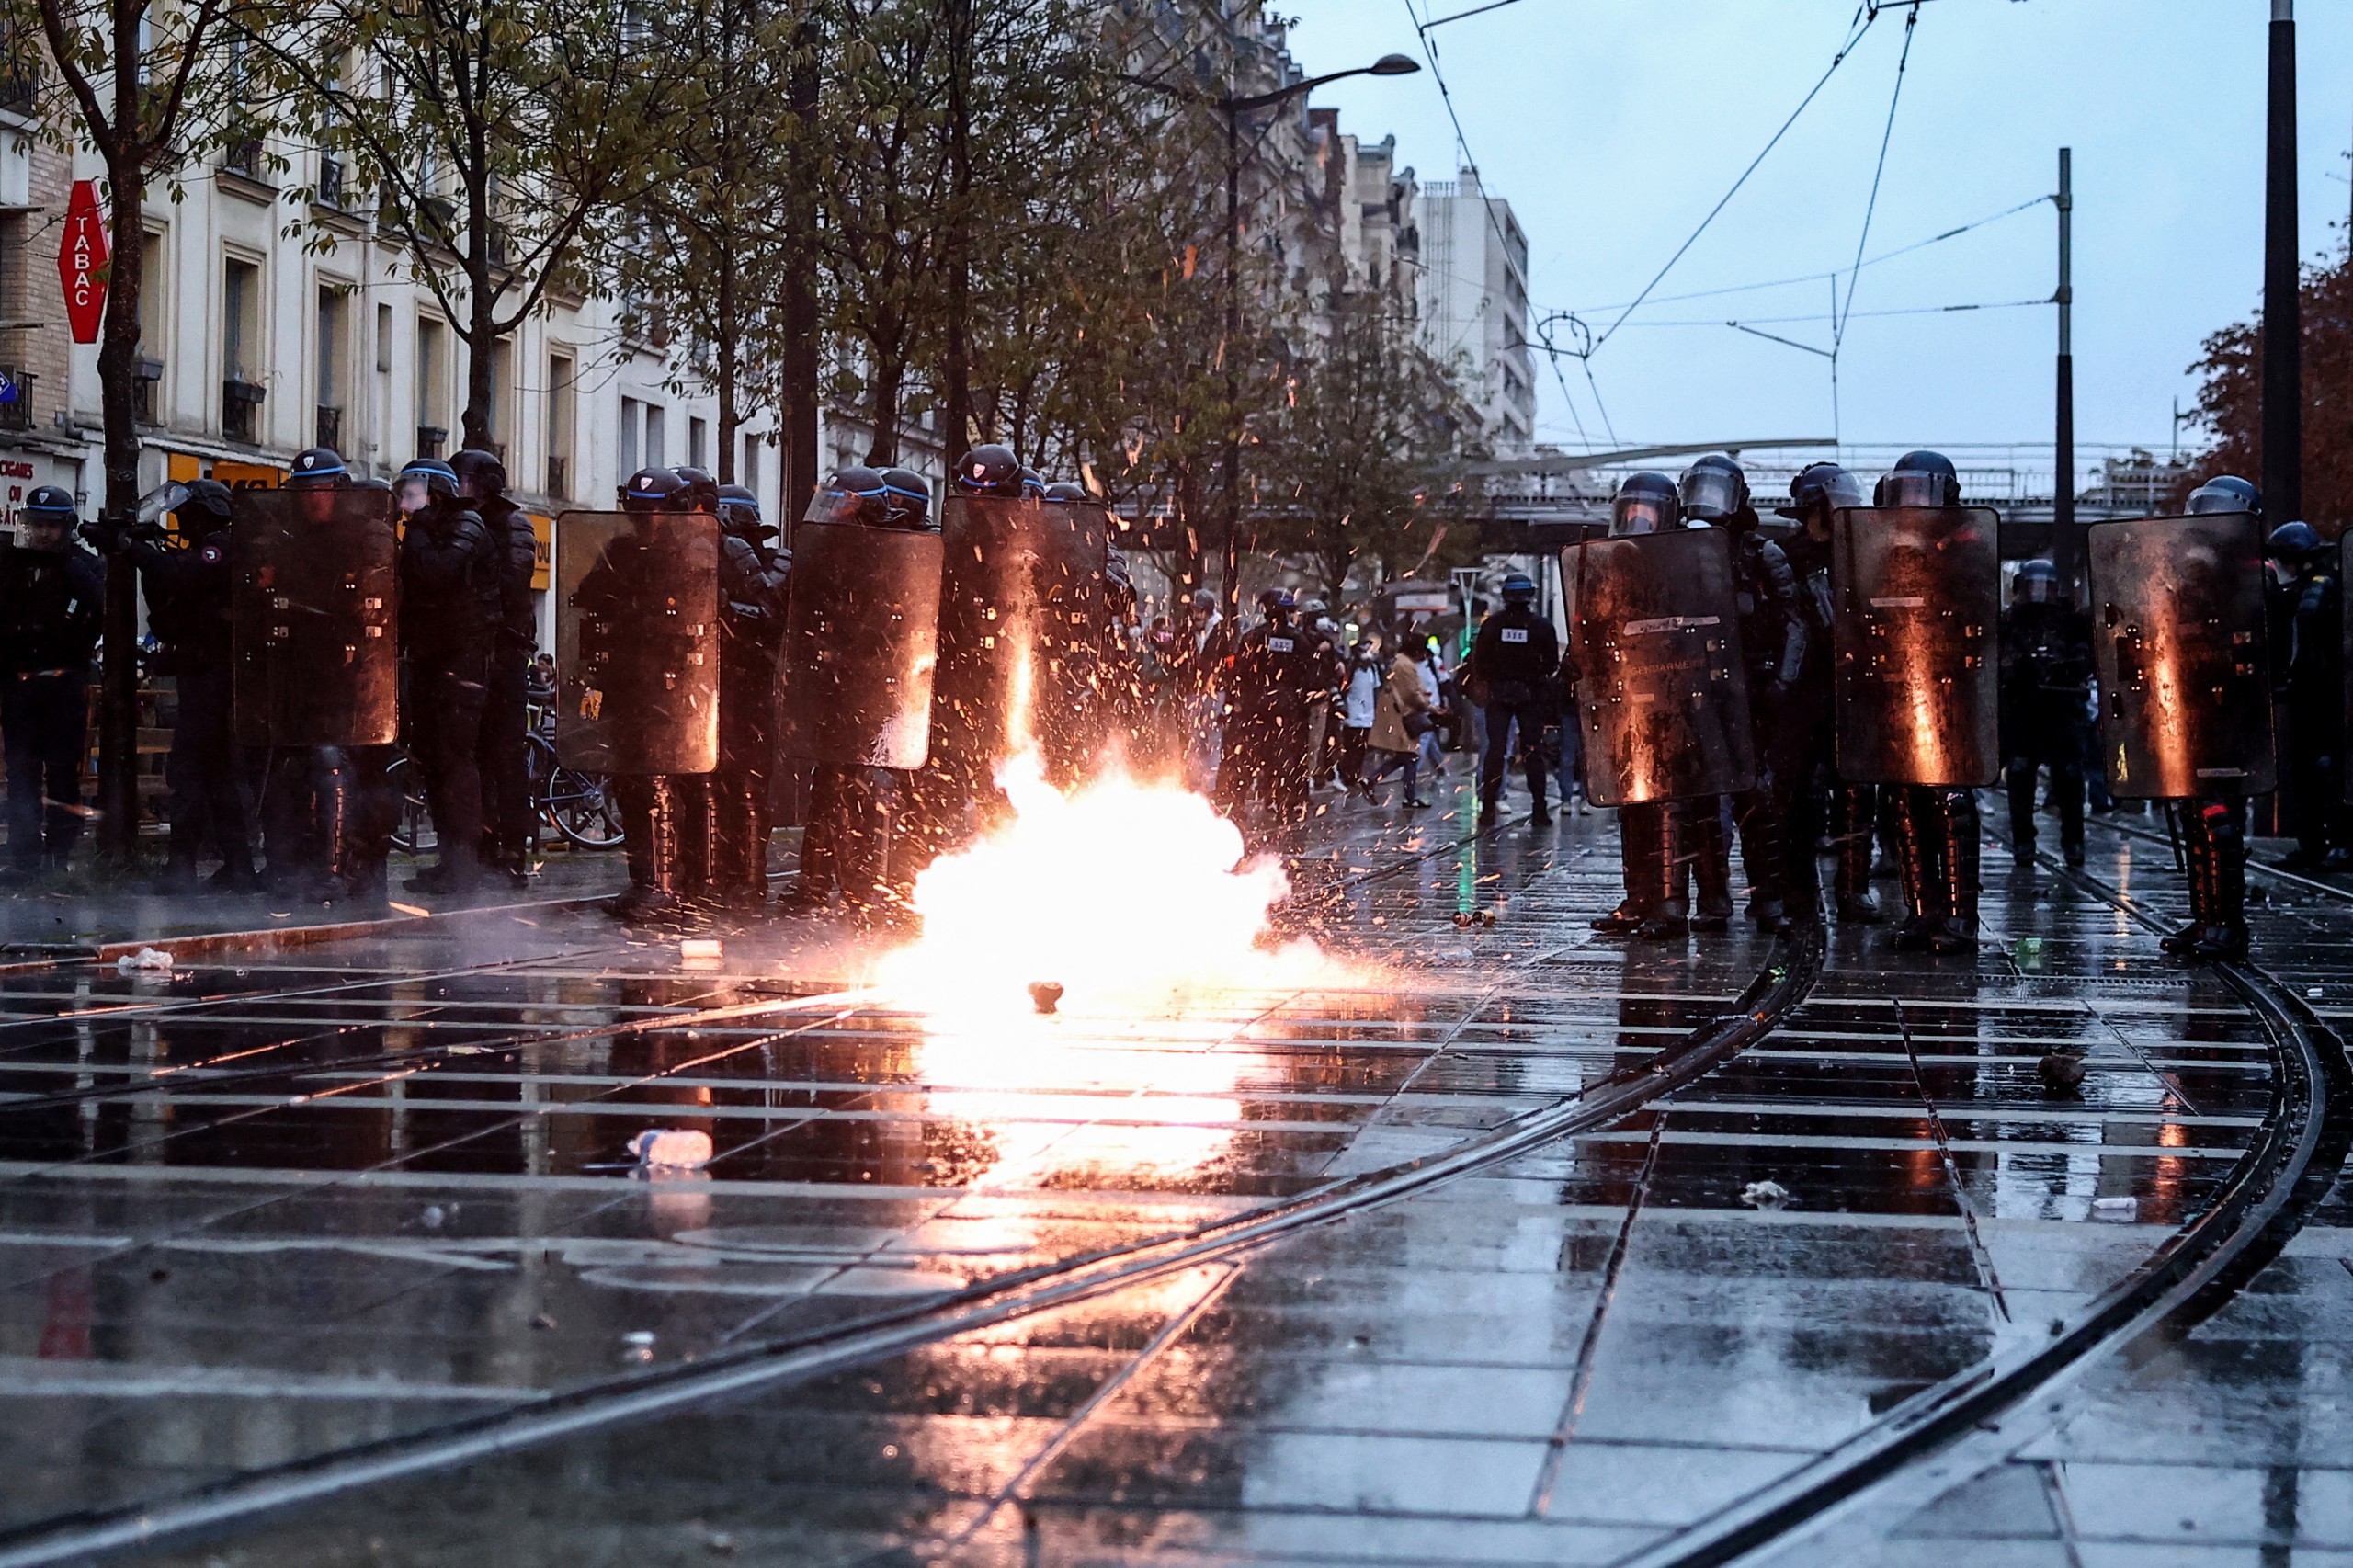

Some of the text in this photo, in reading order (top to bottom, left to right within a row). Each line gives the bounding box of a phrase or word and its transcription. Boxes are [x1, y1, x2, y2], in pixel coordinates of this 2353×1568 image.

[74, 216, 90, 306] TABAC
[9, 484, 22, 502] OU
[535, 540, 551, 563] OU
